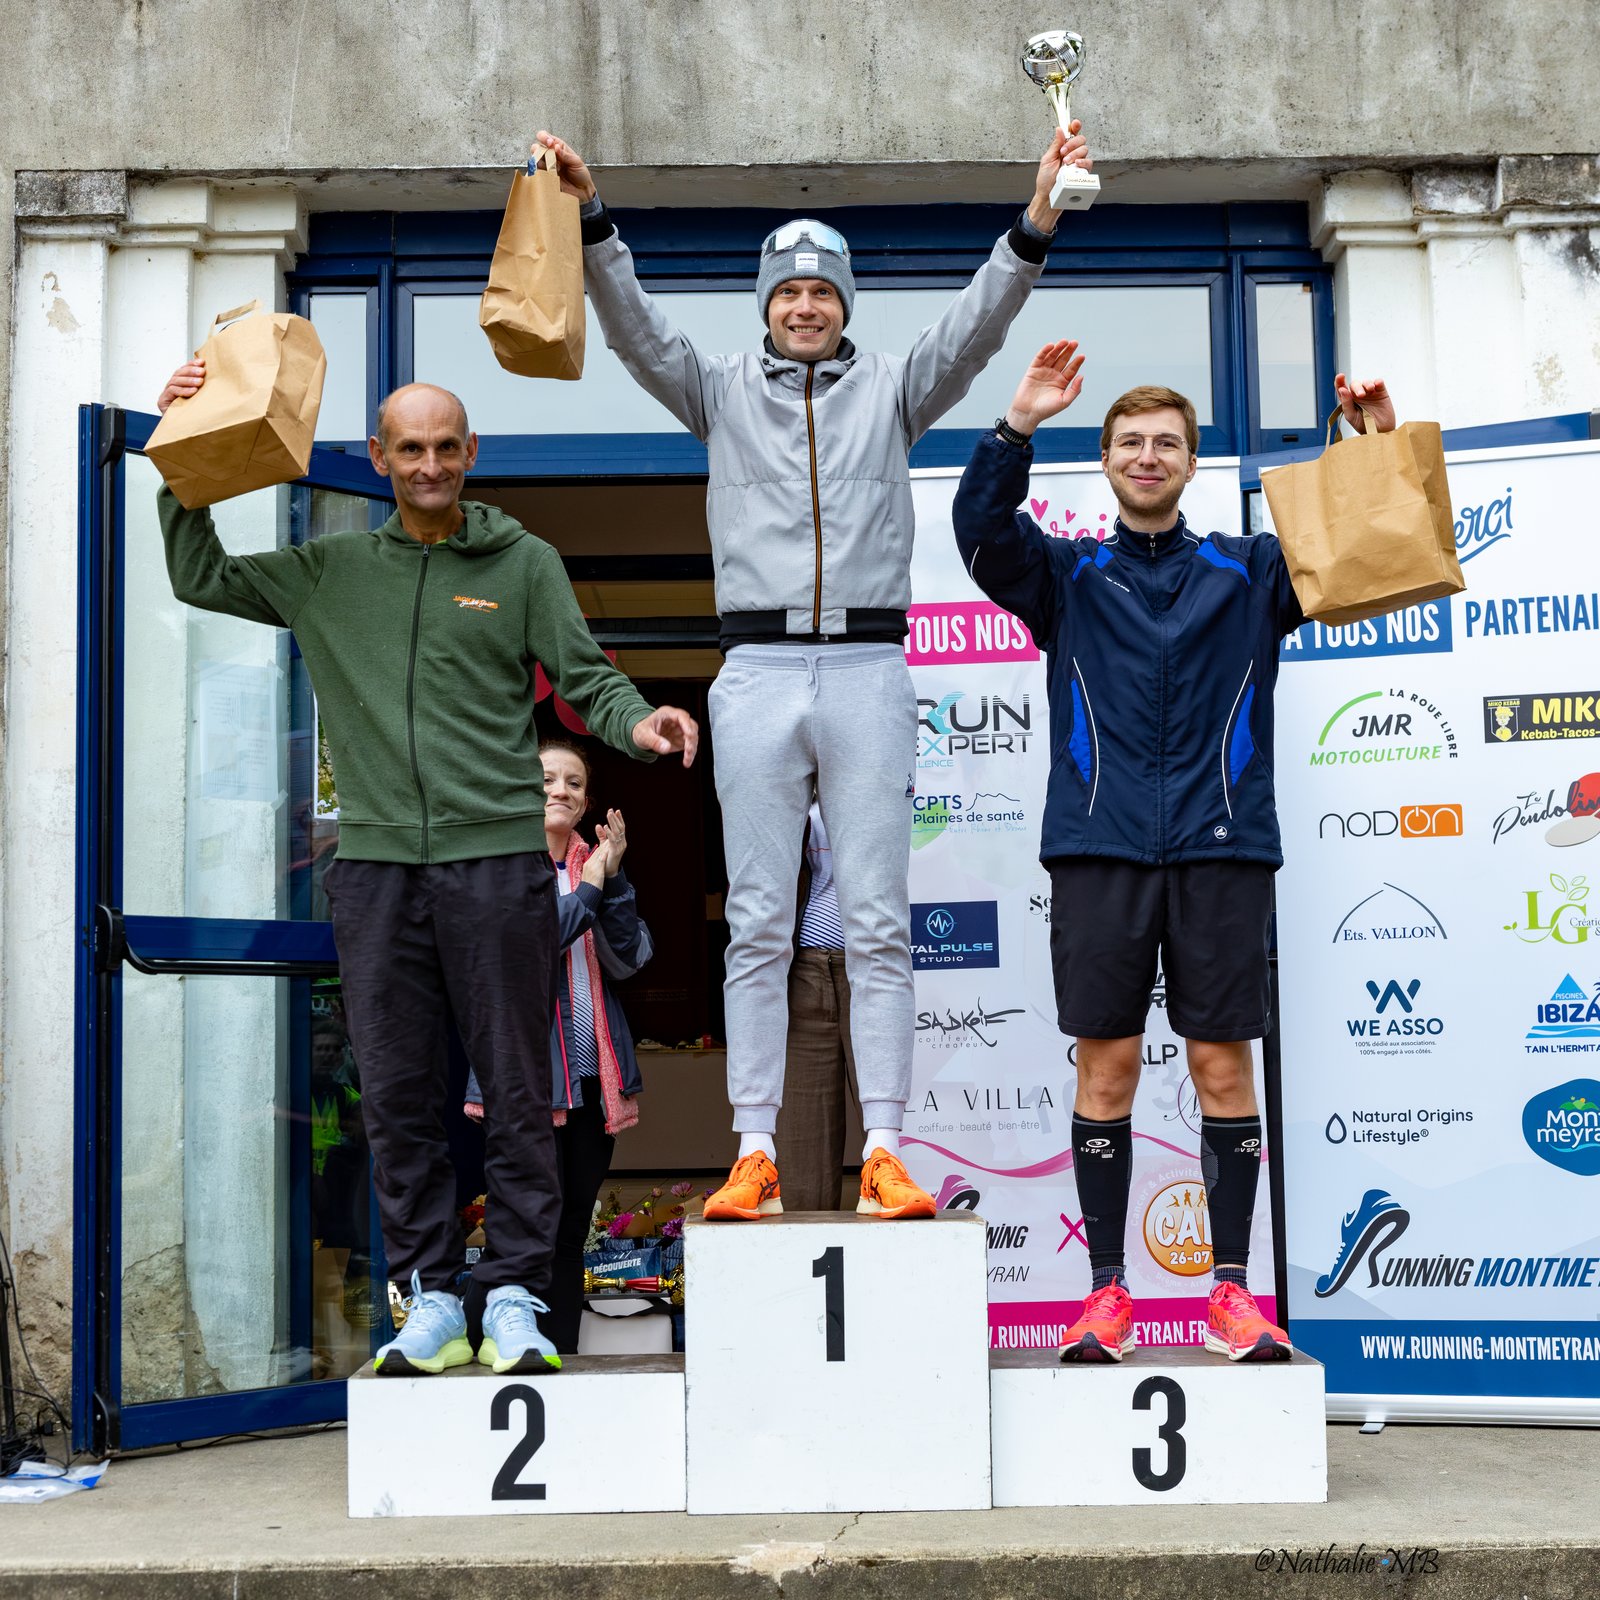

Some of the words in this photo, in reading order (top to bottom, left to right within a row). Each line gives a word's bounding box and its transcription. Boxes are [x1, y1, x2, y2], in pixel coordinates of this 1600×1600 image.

[1453, 486, 1513, 549] erci
[974, 613, 1028, 651] NOS
[1386, 603, 1440, 644] NOS
[1352, 713, 1412, 738] JMR
[1389, 688, 1405, 698] LA
[1410, 693, 1442, 720] ROUE
[1440, 721, 1458, 759] LIBRE
[916, 731, 1033, 757] XPERT
[917, 759, 954, 768] LENCE
[1309, 745, 1443, 766] MOTOCULTURE
[912, 795, 962, 811] CPTS
[913, 813, 963, 824] Plaines
[966, 812, 983, 822] de
[987, 809, 1025, 821] santé
[1343, 928, 1367, 941] Ets.
[1371, 926, 1436, 940] VALLON
[909, 945, 938, 954] TAL
[940, 943, 993, 952] PULSE
[1347, 1019, 1381, 1036] WE
[1386, 1018, 1444, 1035] ASSO
[1525, 1045, 1549, 1053] TAIN
[963, 1087, 1054, 1111] VILLA
[918, 1122, 954, 1133] coiffure
[960, 1121, 992, 1131] beauté
[998, 1120, 1040, 1131] bien-être
[1352, 1109, 1412, 1123] Natural
[1416, 1109, 1474, 1125] Origins
[1546, 1109, 1600, 1128] Mon
[1158, 1166, 1204, 1182] Activité
[593, 1257, 642, 1275] DÉCOUVERTE
[1169, 1250, 1210, 1265] 26-07
[1474, 1257, 1600, 1287] MONTME
[812, 1246, 845, 1362] 1
[490, 1383, 547, 1501] 2
[1132, 1375, 1187, 1492] 3
